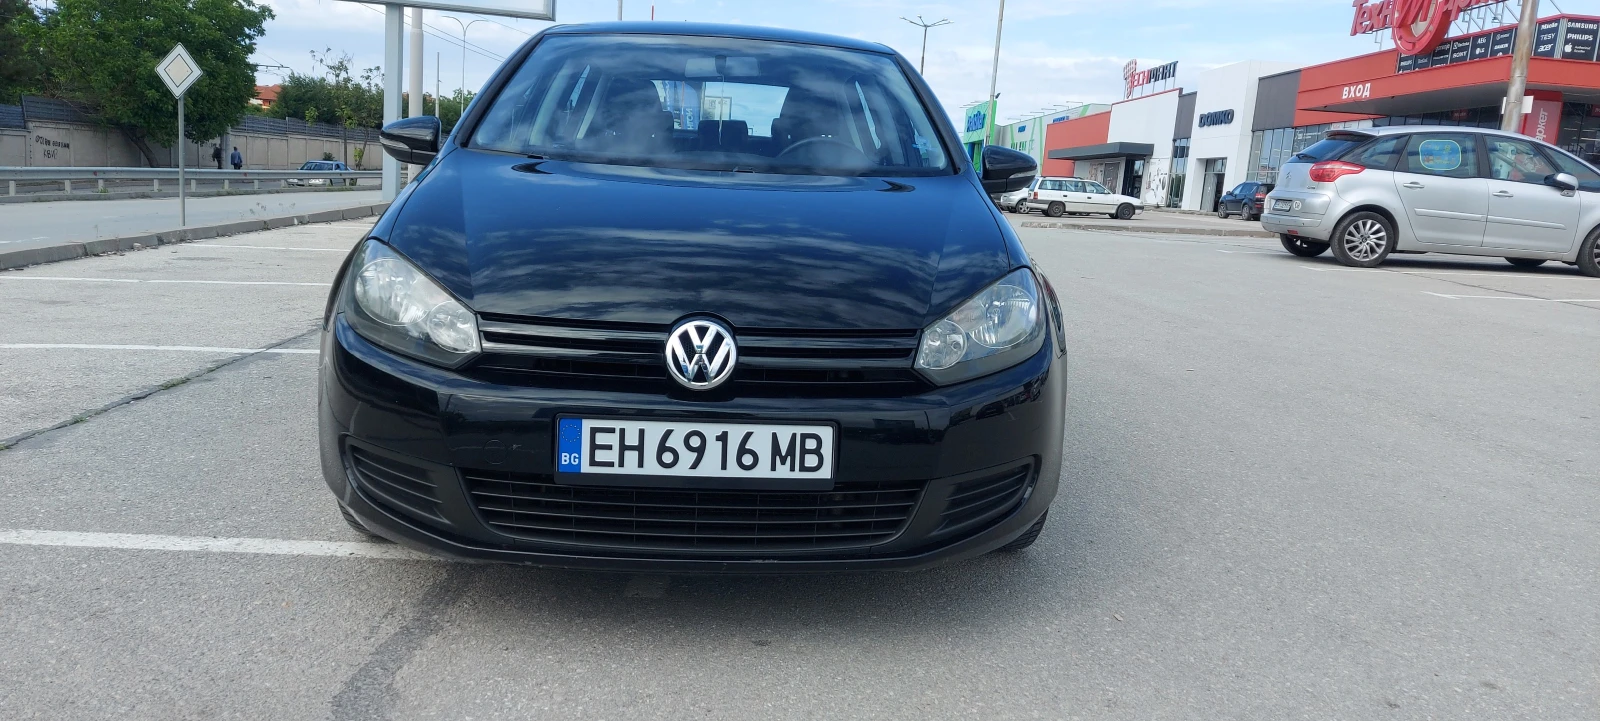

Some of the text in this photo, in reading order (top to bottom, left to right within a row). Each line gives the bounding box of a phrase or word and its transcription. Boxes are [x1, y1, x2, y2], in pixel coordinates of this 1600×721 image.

[1567, 22, 1598, 30] SAMSUNG
[1476, 36, 1487, 44] AEG
[1540, 32, 1556, 41] TESY
[1566, 33, 1594, 41] PHILIPS
[1537, 43, 1554, 52] acer
[1342, 82, 1372, 100] ВХОД
[1198, 108, 1235, 128] DOMKO
[588, 426, 825, 474] EH 6916 MB
[560, 452, 580, 466] BG
